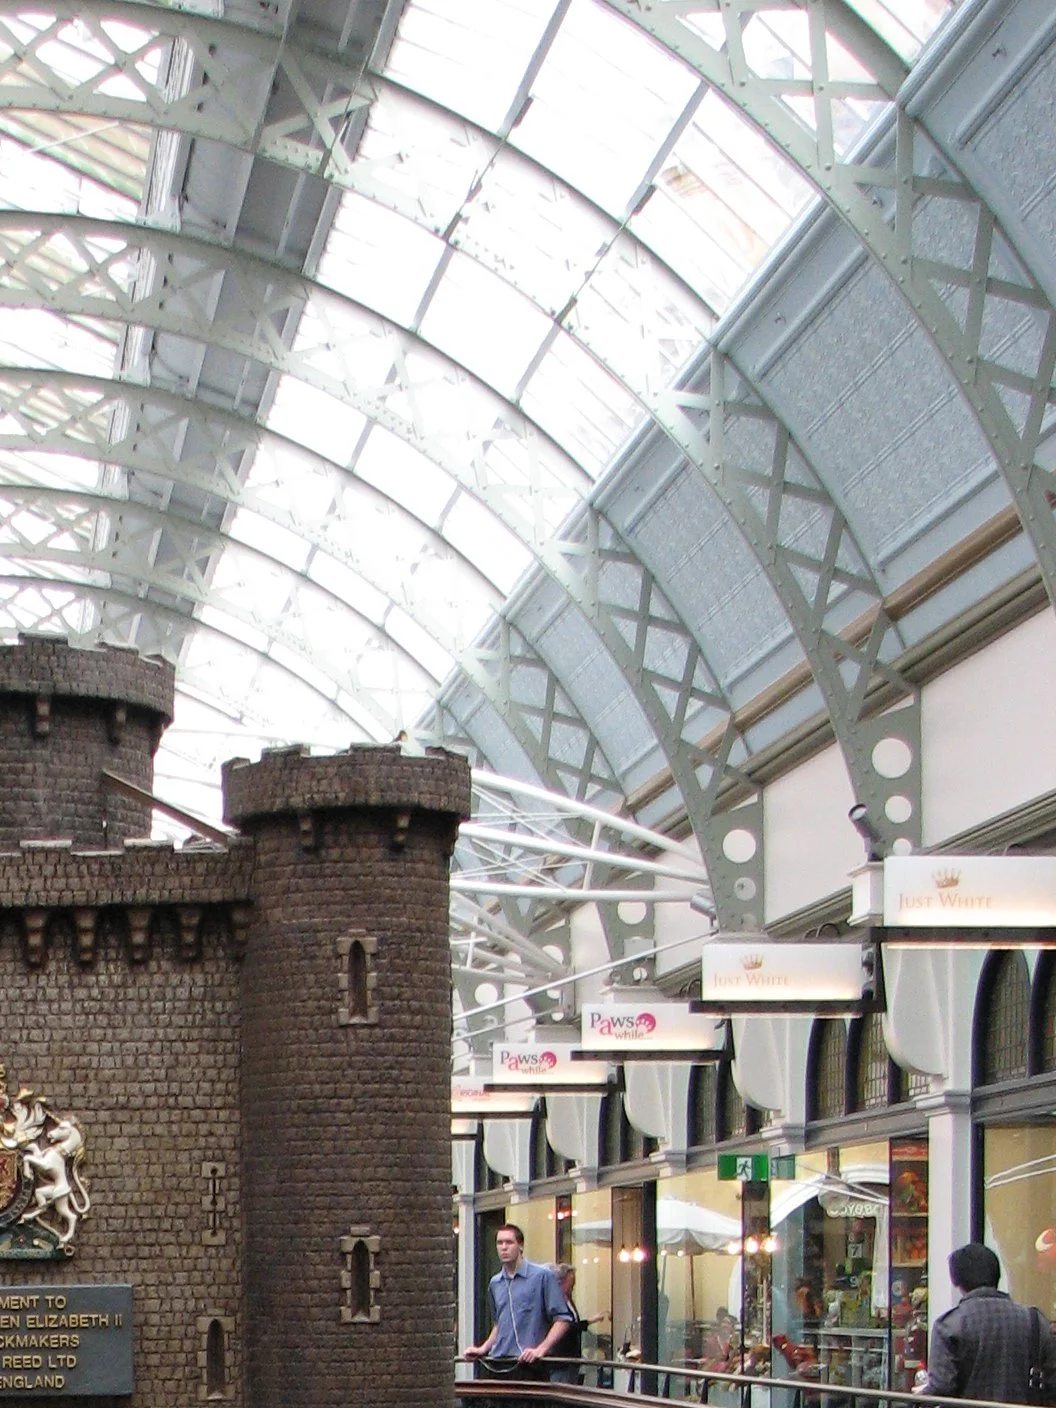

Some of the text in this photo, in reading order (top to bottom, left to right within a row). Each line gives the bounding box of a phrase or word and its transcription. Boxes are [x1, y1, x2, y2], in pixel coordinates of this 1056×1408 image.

[45, 1295, 67, 1310] TO
[26, 1313, 109, 1328] ELIZABETH
[114, 1313, 123, 1327] II
[2, 1355, 42, 1369] REED
[48, 1354, 77, 1369] LTD
